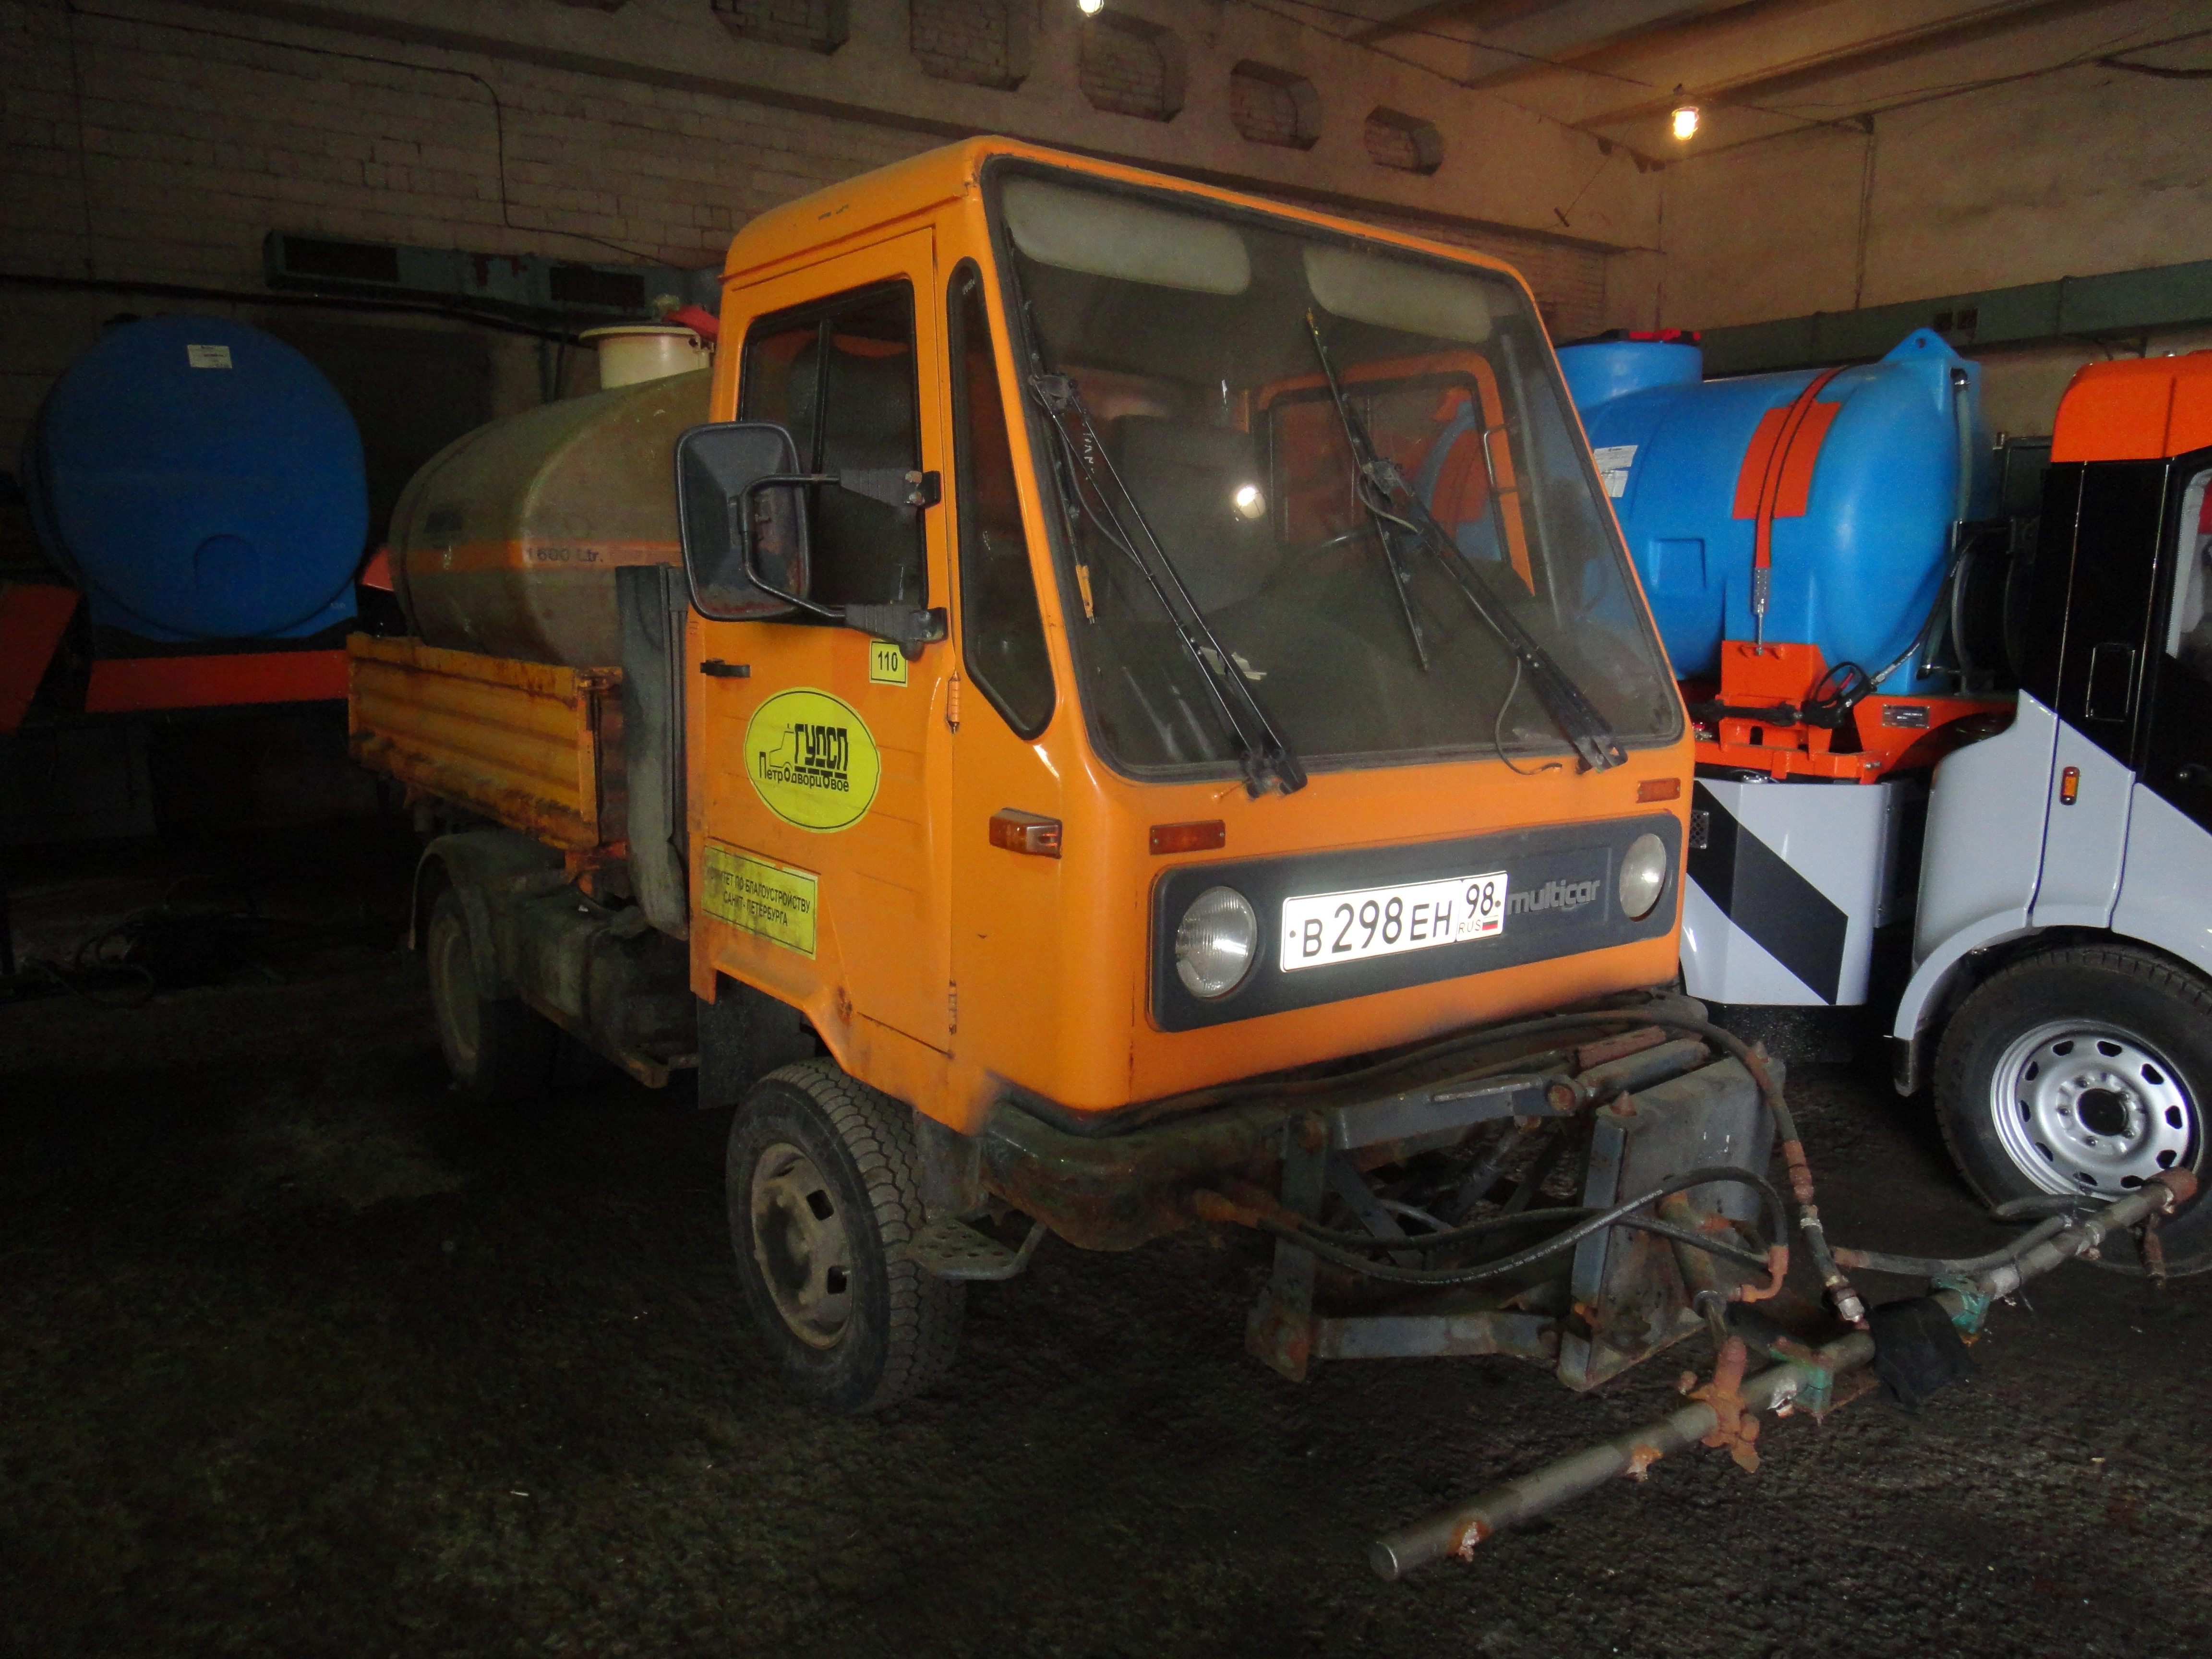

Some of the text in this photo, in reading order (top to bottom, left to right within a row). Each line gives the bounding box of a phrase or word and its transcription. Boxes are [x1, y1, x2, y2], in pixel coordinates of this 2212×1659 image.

[878, 650, 898, 672] 110
[745, 879, 811, 914] БЛАГОУСТРОЙСТВУ
[1466, 881, 1495, 919] 98
[1505, 879, 1600, 915] multicar
[1458, 919, 1481, 934] RUS
